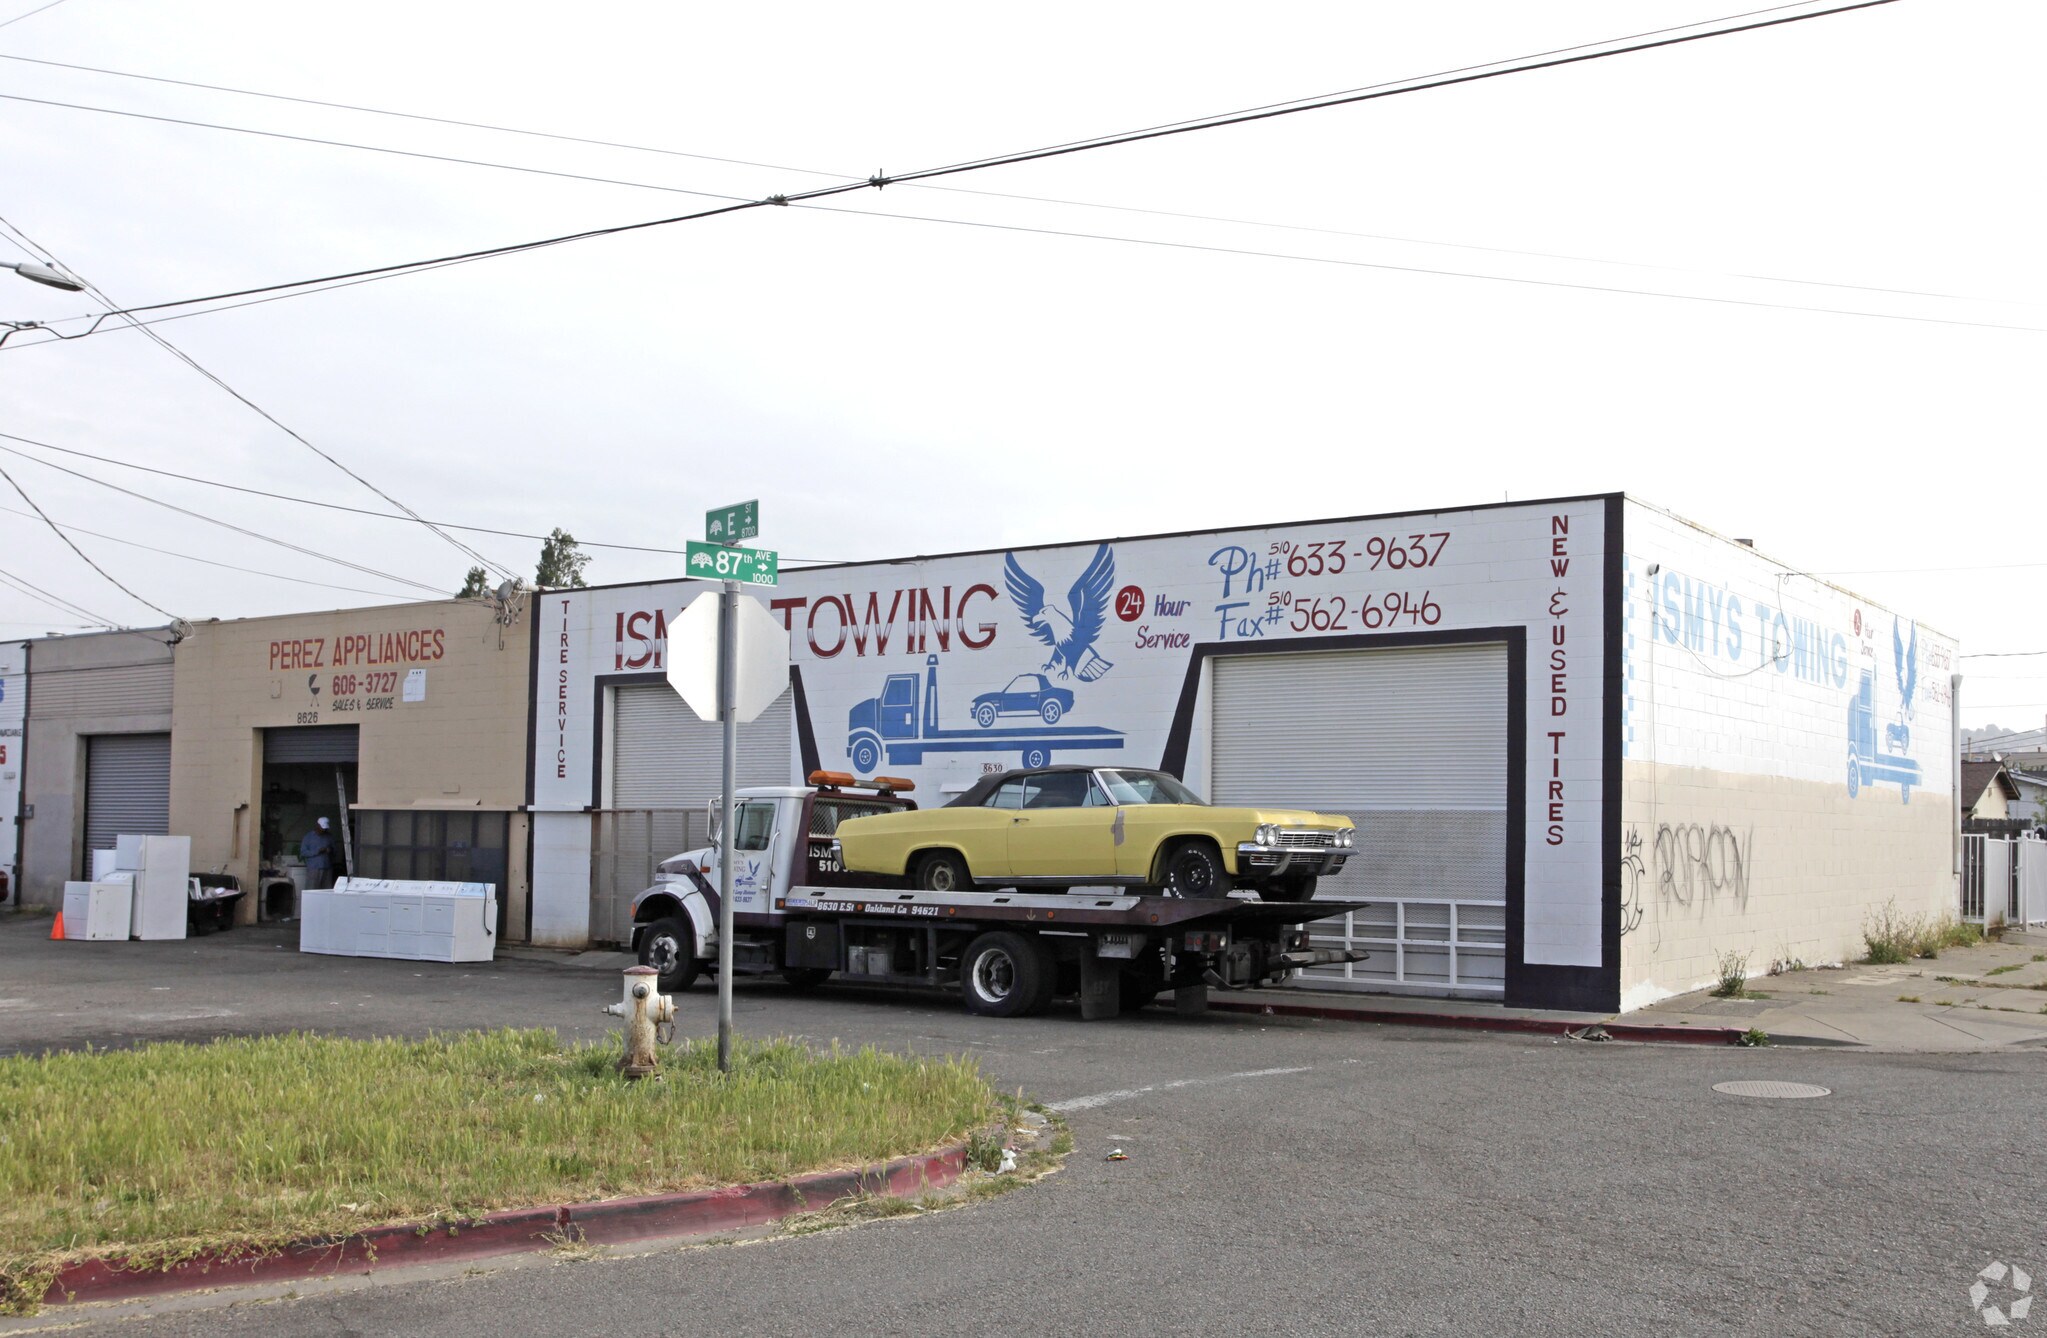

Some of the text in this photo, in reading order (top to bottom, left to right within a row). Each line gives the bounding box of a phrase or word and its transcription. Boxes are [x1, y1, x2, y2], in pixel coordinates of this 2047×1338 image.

[727, 503, 752, 536] E ST
[741, 526, 756, 538] 8700
[755, 551, 772, 562] AVE
[1287, 532, 1450, 577] 633-9637
[1550, 514, 1570, 578] NEW
[752, 573, 774, 585] 1000
[1120, 592, 1191, 617] 24 Hour
[1290, 590, 1442, 632] 562-6946
[771, 583, 1000, 661] TOWING
[1651, 570, 1848, 690] ISMY'S TOWING
[269, 629, 445, 671] PEREZ APPLIANCES
[1135, 625, 1190, 650] Service
[332, 672, 398, 696] 606-3727
[1549, 624, 1567, 717] USED
[557, 600, 570, 778] TIRE SERVICE
[296, 712, 319, 724] 8626
[332, 699, 355, 711] SALES
[366, 697, 395, 711] SERVICE
[983, 763, 1003, 773] 8630
[1545, 732, 1566, 847] TIRES
[817, 902, 838, 911] 8630
[865, 904, 895, 913] Oakland
[897, 905, 907, 914] Ca
[911, 906, 939, 916] 94621
